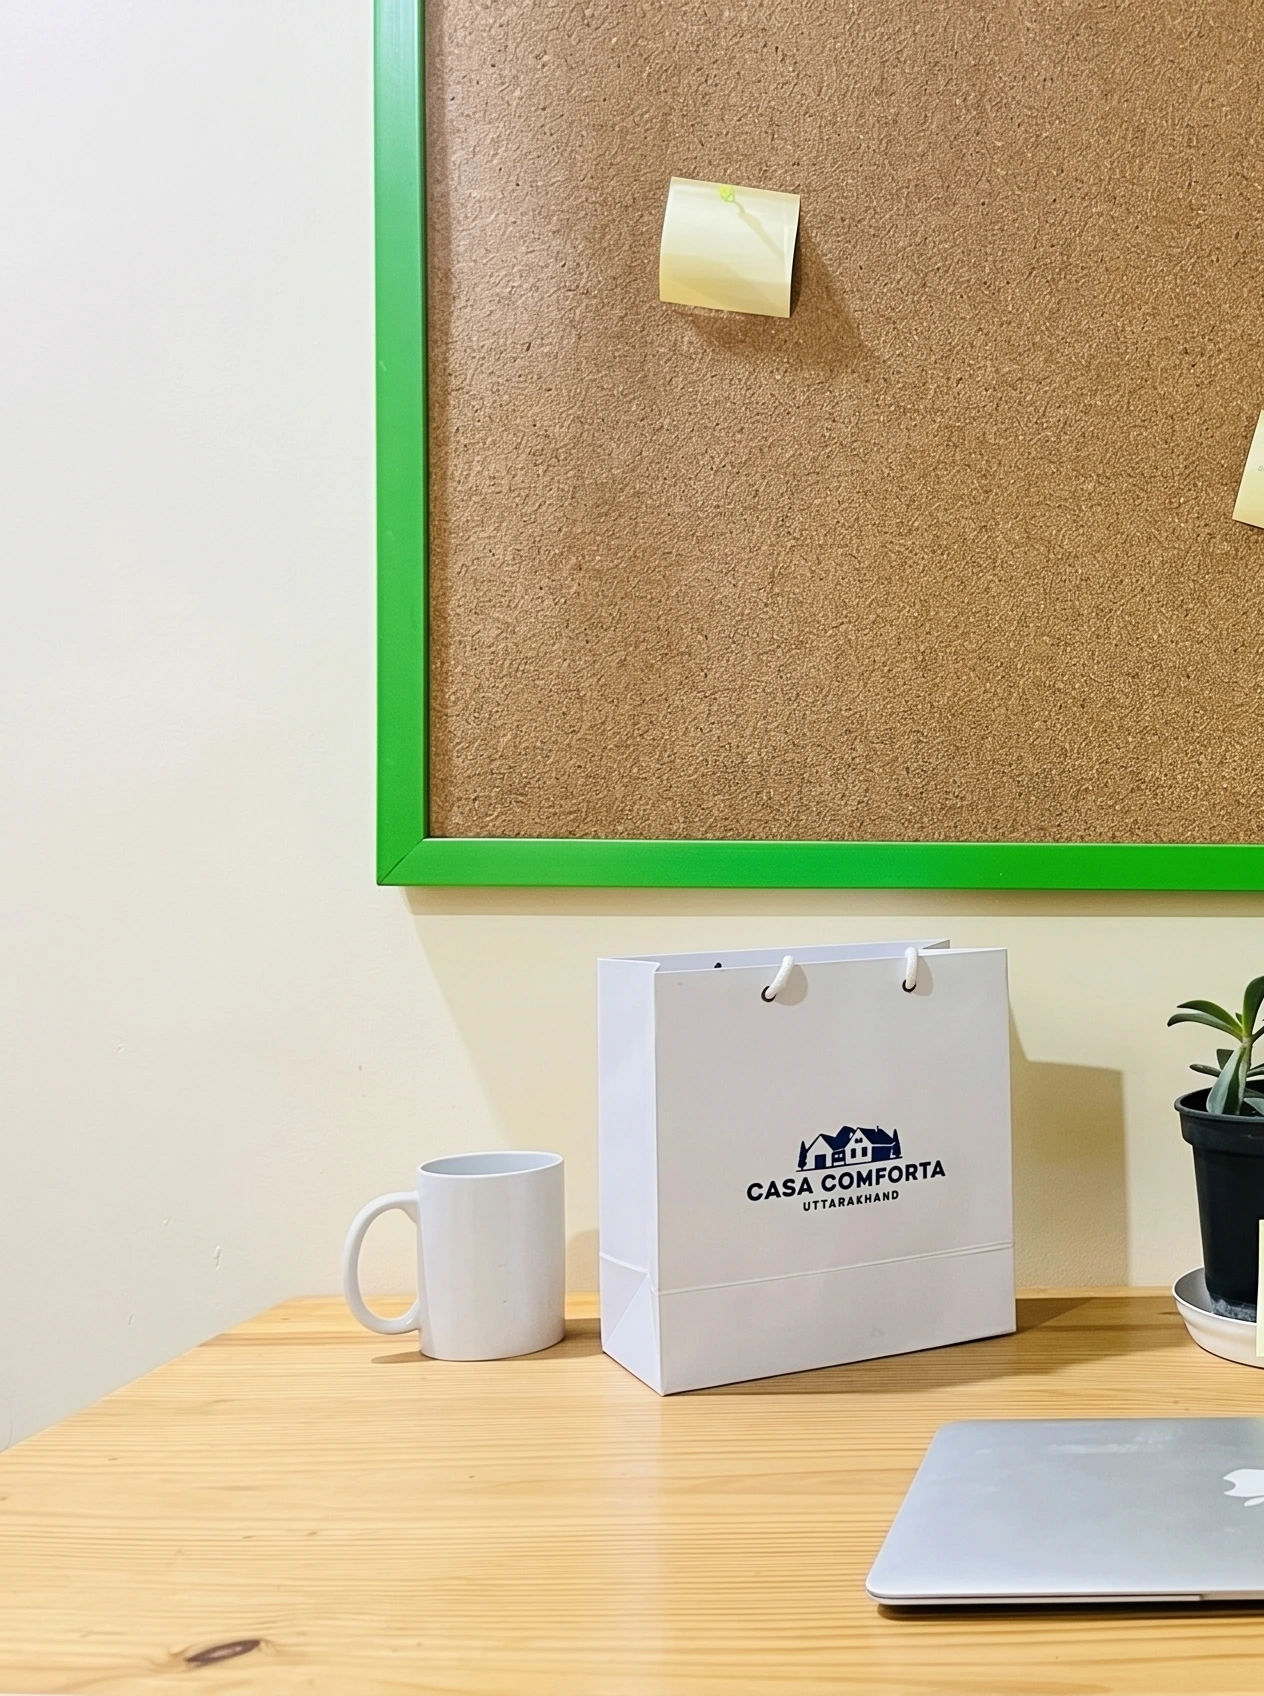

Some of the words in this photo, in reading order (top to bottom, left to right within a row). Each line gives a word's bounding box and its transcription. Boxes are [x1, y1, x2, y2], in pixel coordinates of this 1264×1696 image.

[746, 1176, 814, 1202] CASA
[821, 1160, 946, 1192] COMFORTA
[803, 1190, 900, 1212] UTTARAKHAND
